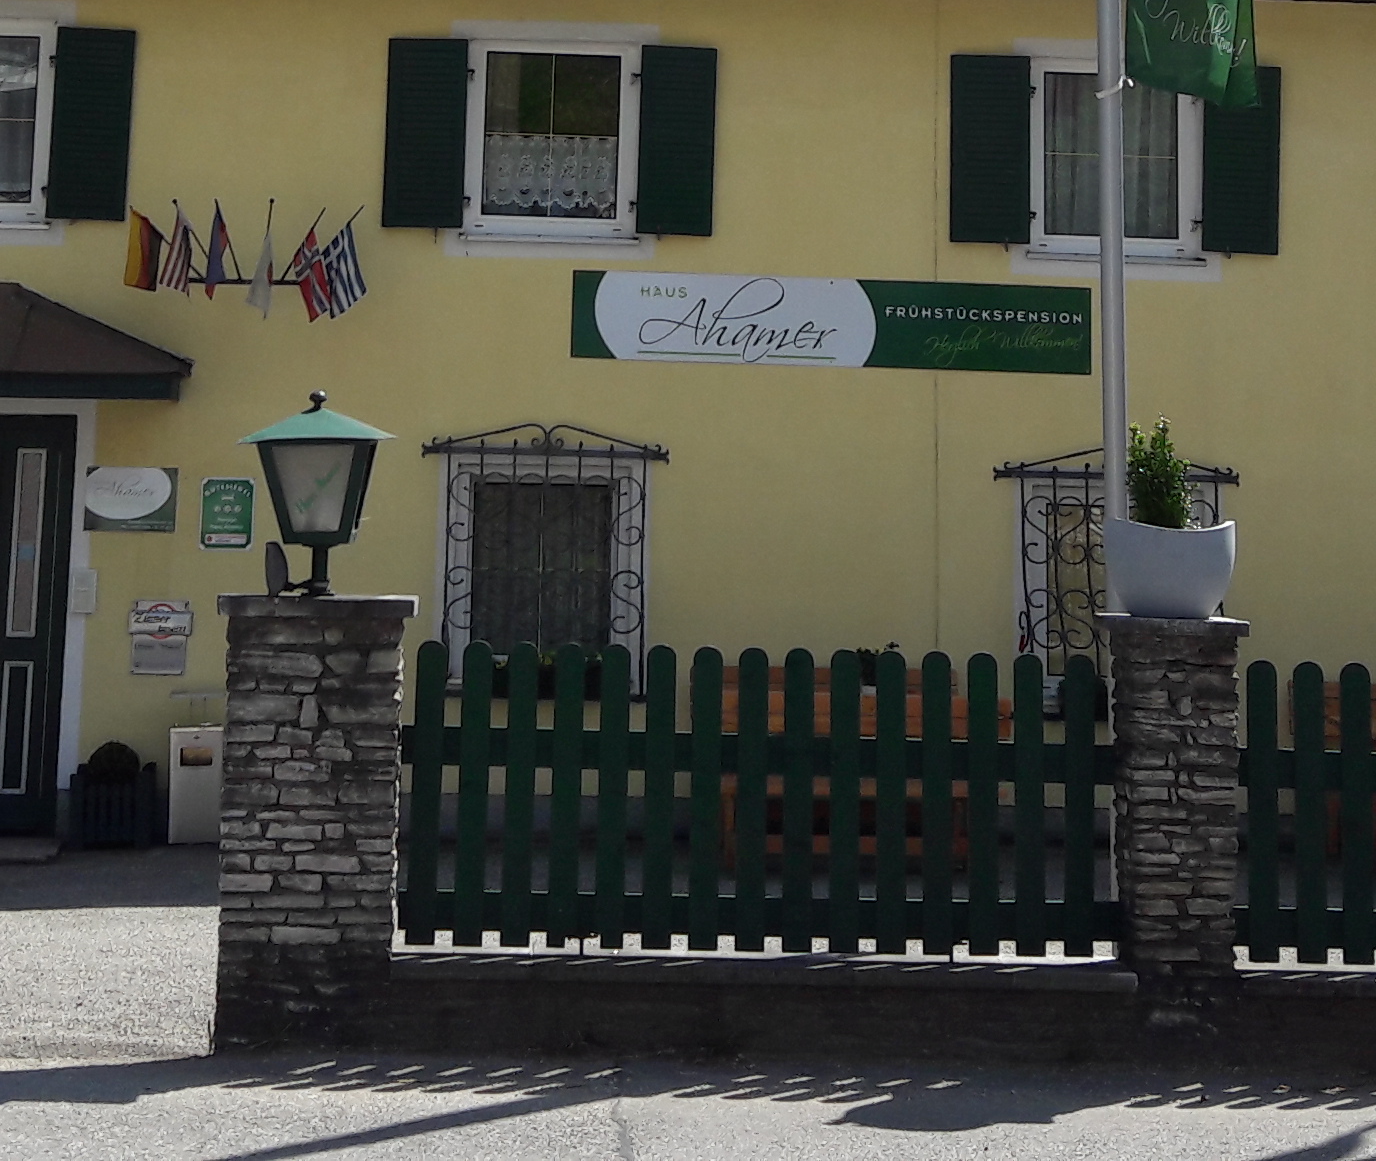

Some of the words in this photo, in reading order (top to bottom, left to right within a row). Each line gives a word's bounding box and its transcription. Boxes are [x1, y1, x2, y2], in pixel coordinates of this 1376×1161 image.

[640, 285, 688, 298] HAUS
[638, 277, 838, 363] Ahamer
[884, 304, 1083, 325] FRÜHSTÜCKSPENSION
